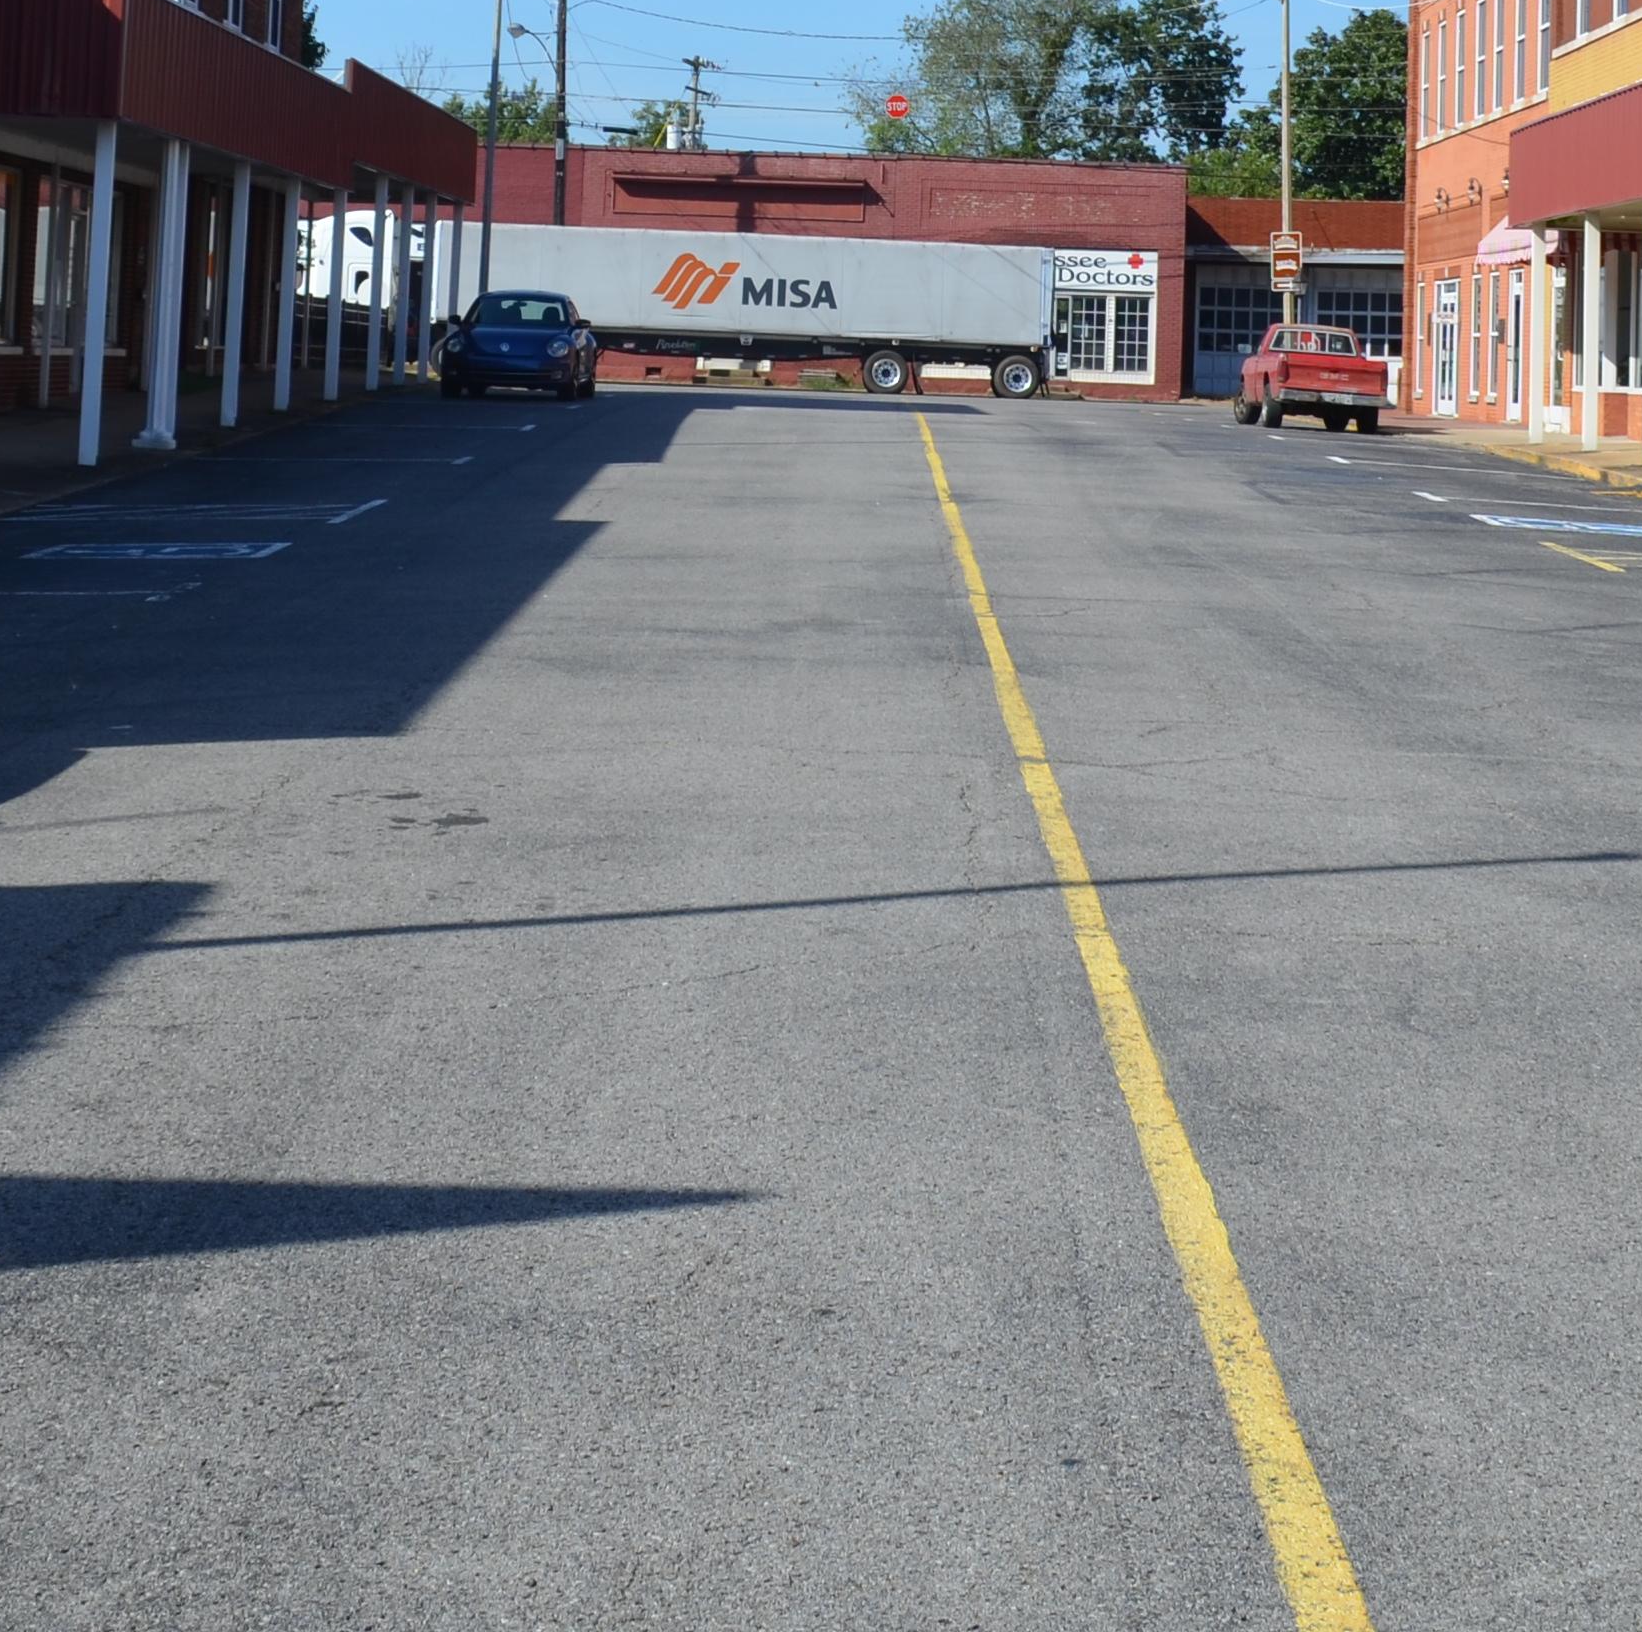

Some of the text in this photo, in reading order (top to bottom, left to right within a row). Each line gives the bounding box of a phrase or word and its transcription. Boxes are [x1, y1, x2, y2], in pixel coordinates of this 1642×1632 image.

[887, 101, 907, 111] STOP
[1058, 268, 1154, 286] Doctors
[742, 277, 837, 309] MISA
